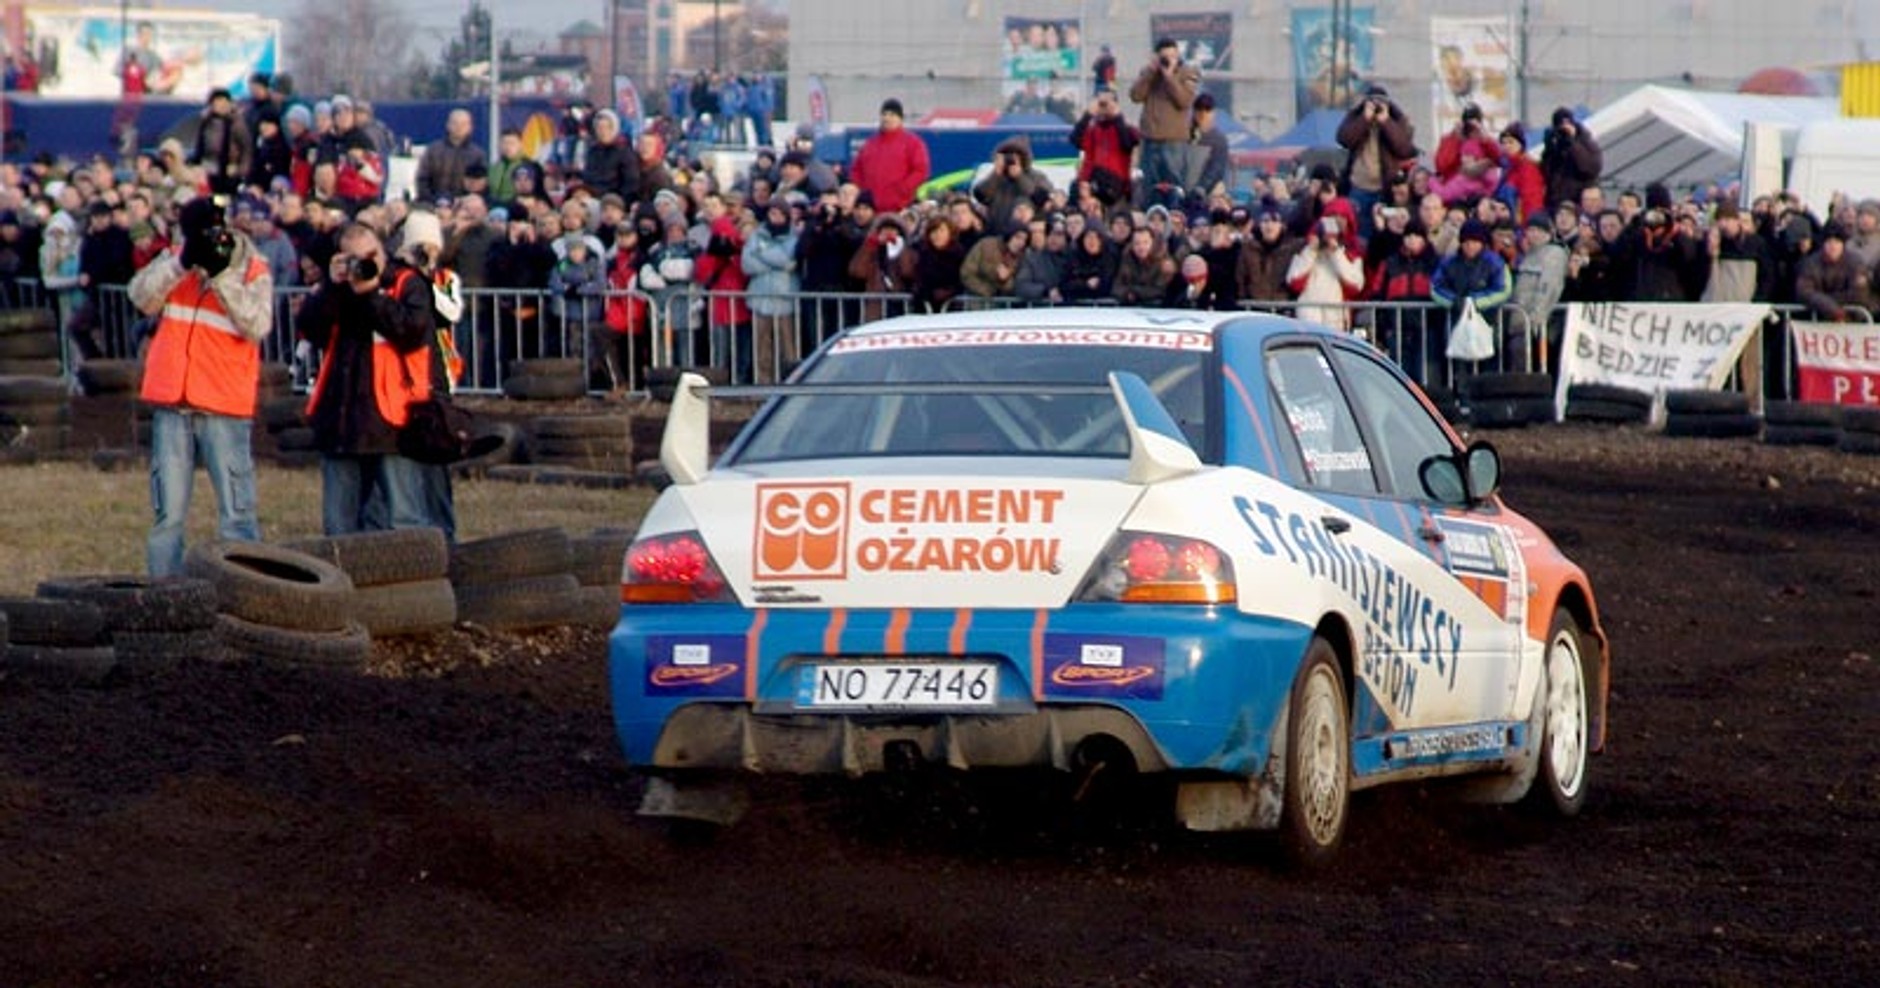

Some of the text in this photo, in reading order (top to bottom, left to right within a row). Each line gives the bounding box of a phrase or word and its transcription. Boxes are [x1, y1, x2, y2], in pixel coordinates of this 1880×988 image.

[1580, 303, 1671, 346] NIECH
[859, 488, 1065, 524] CEMENT
[856, 526, 1062, 573] OŻARÓW
[1232, 495, 1463, 692] STANISZEWSCY
[819, 667, 988, 701] NO 77446
[1063, 665, 1134, 679] SPORT
[1363, 620, 1418, 719] BETON
